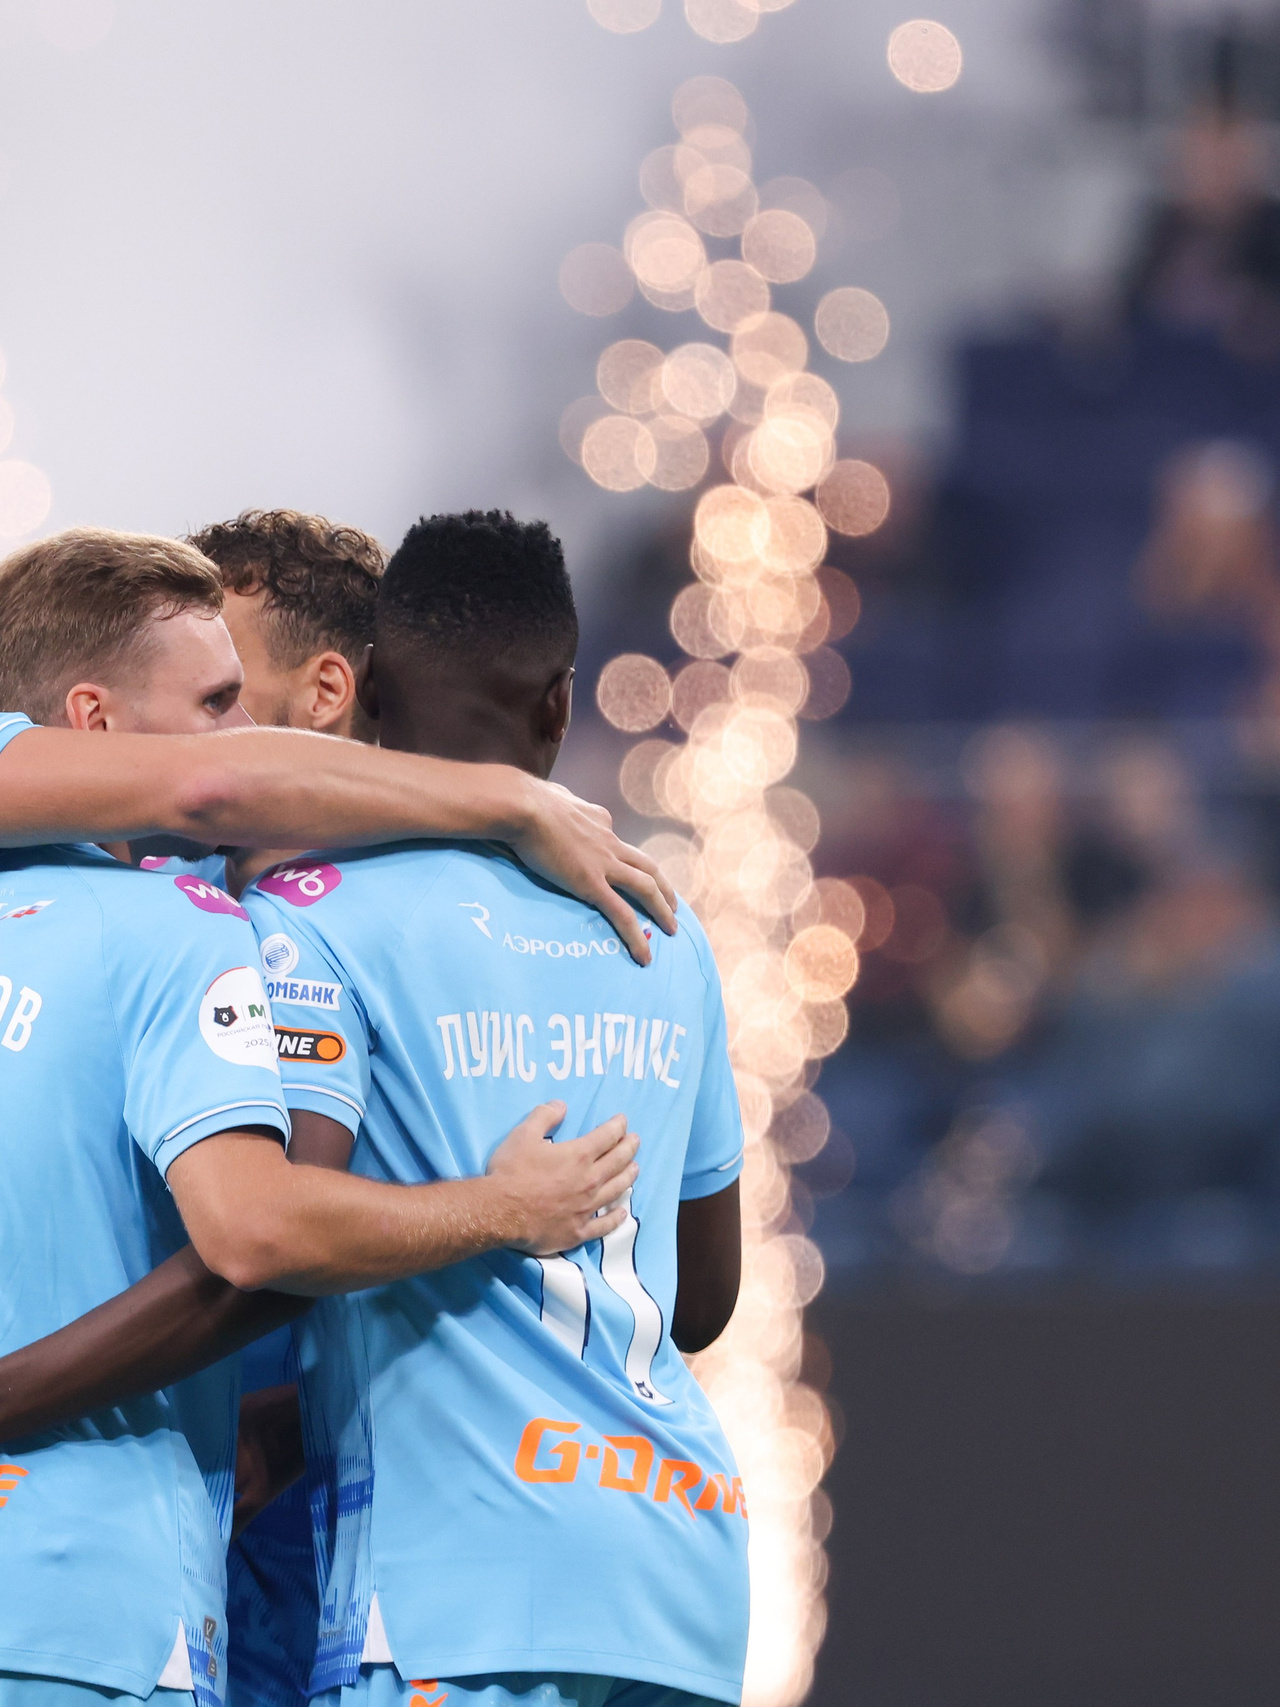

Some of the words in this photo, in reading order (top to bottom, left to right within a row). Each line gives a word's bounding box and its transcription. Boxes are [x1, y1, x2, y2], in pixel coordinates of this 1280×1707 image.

[502, 932, 629, 959] АЭРОФЛО
[436, 1010, 537, 1083] ЛУИС
[547, 1013, 687, 1089] ЭНРИКЕ
